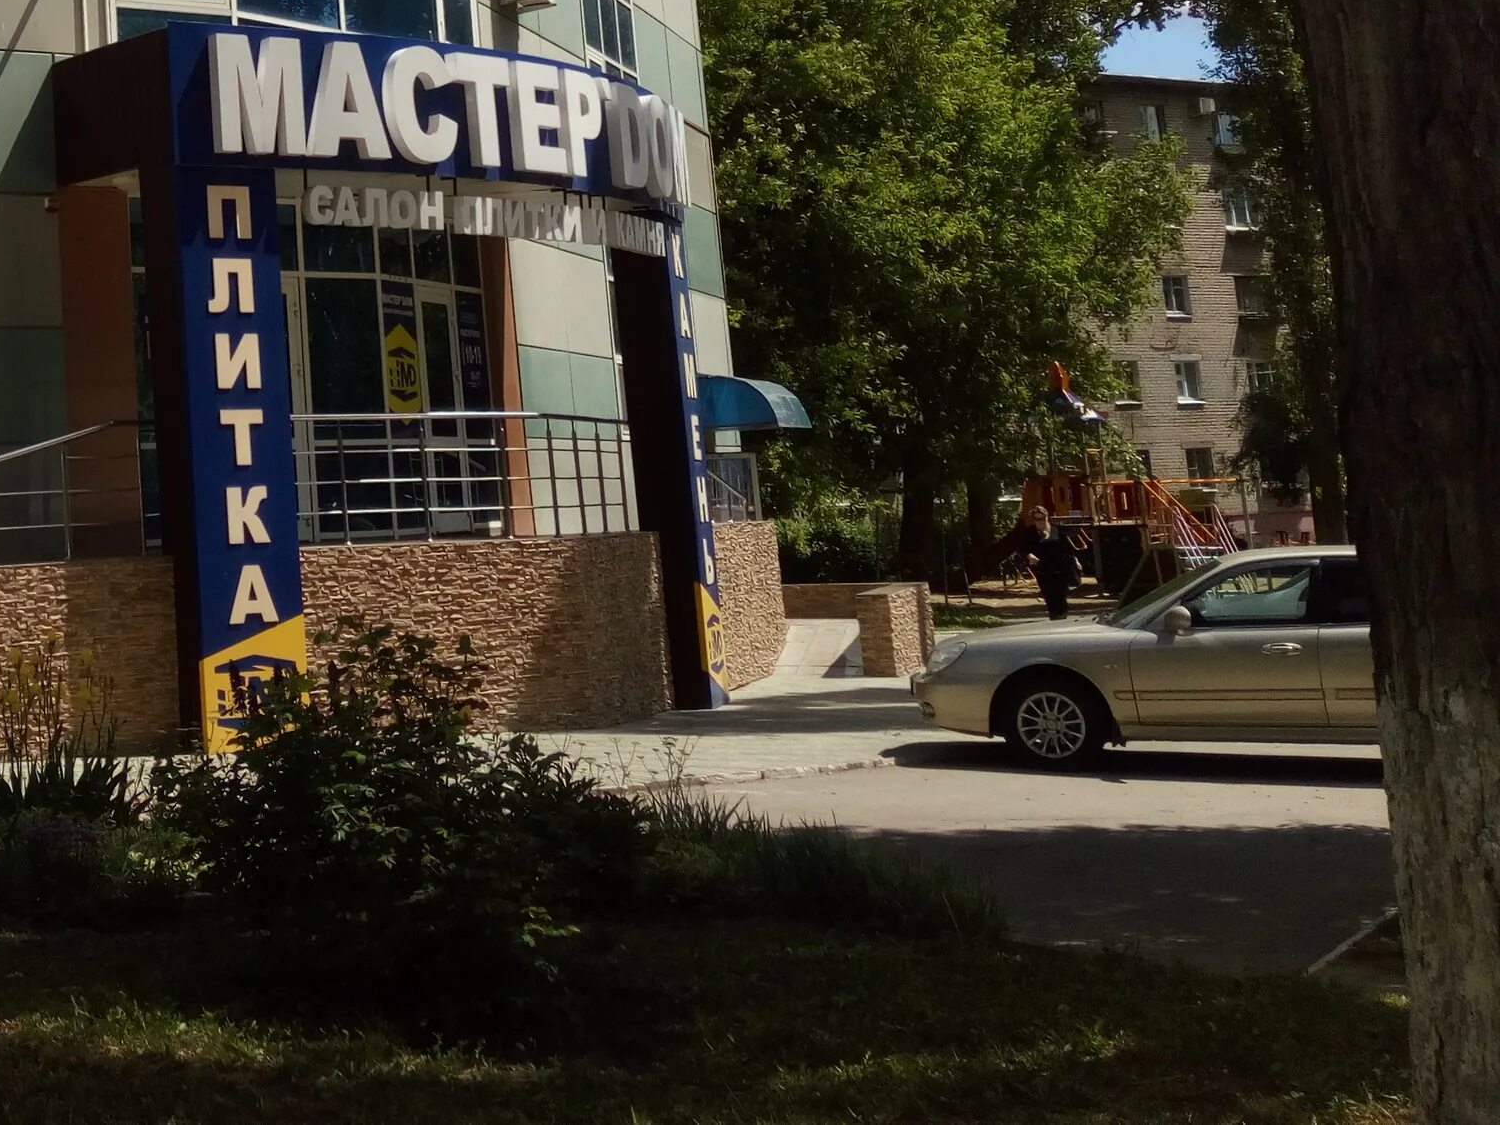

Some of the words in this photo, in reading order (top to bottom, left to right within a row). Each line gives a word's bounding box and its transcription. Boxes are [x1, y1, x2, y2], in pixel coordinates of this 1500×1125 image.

[304, 184, 445, 231] САЛОН
[455, 196, 583, 243] ПЛИТКИ
[614, 211, 666, 257] КАМНЯ
[206, 184, 280, 625] ПЛИТКА
[671, 233, 715, 585] КАМЕНЬ
